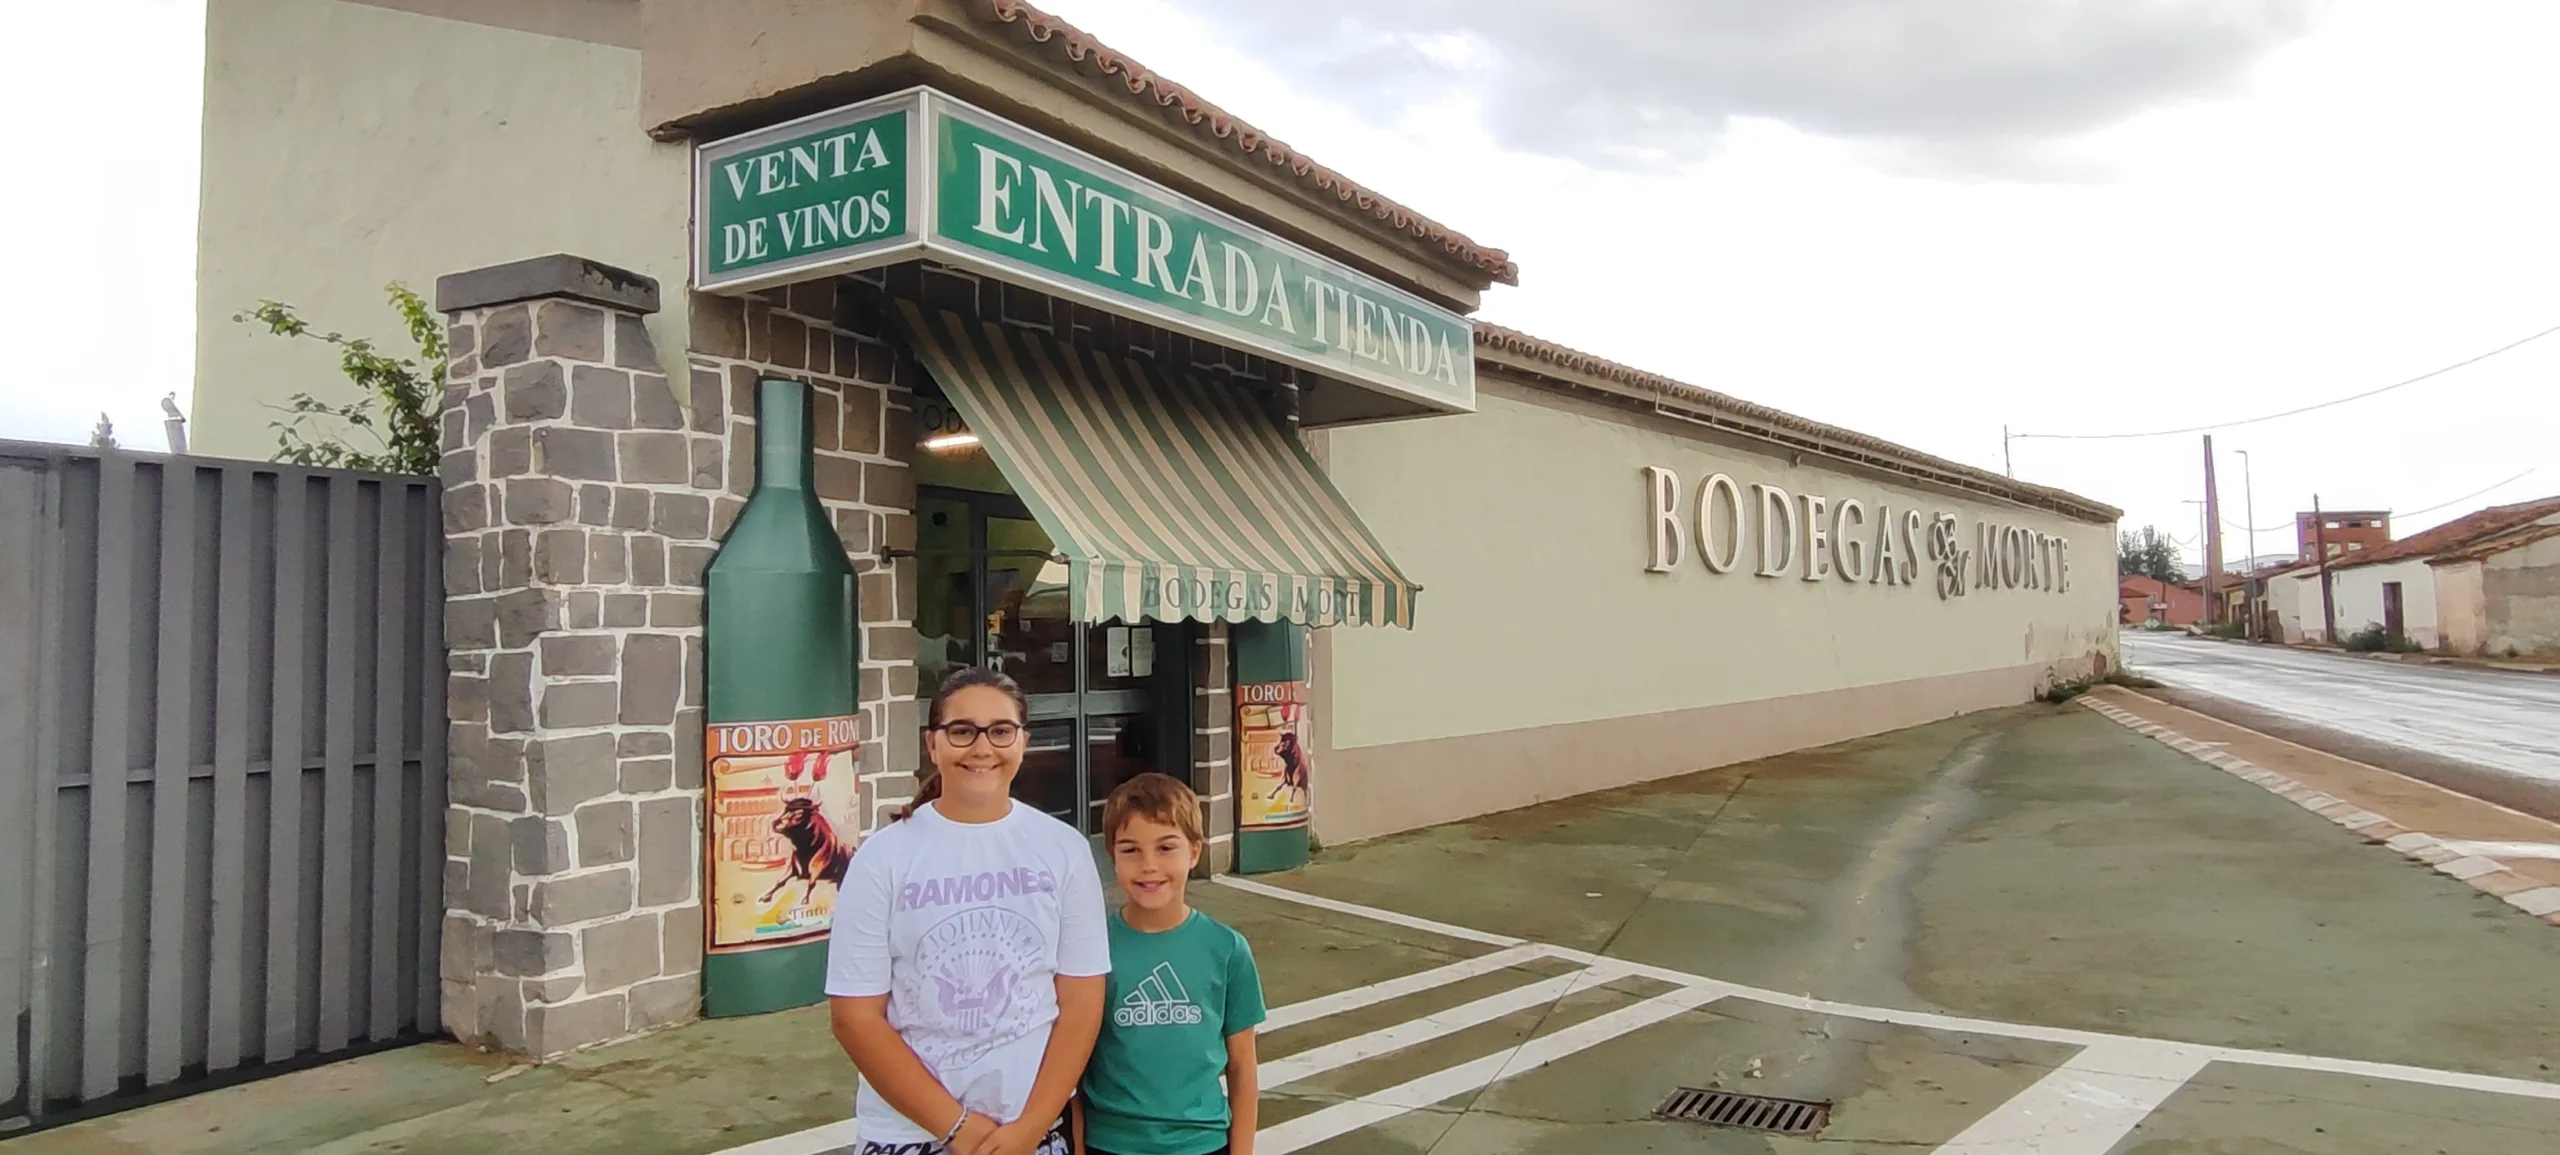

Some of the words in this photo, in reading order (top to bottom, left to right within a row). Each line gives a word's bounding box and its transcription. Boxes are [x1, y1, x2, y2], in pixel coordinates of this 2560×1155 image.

[724, 127, 891, 202] VENTA
[723, 216, 768, 265] DE
[777, 189, 891, 252] VINOS
[972, 142, 1297, 333] ENTRADA
[1304, 272, 1458, 387] TIENDA
[1643, 465, 1922, 585] BODEGAS
[1975, 521, 2071, 594] MORTE
[1144, 577, 1272, 611] BODEGAS
[1241, 684, 1285, 702] TORO
[717, 723, 793, 753] TORO
[801, 728, 823, 748] DE
[900, 866, 1057, 912] RAMONES
[788, 904, 828, 921] Tinto
[928, 909, 1029, 950] JOHNNY
[1114, 1002, 1202, 1027] adidas
